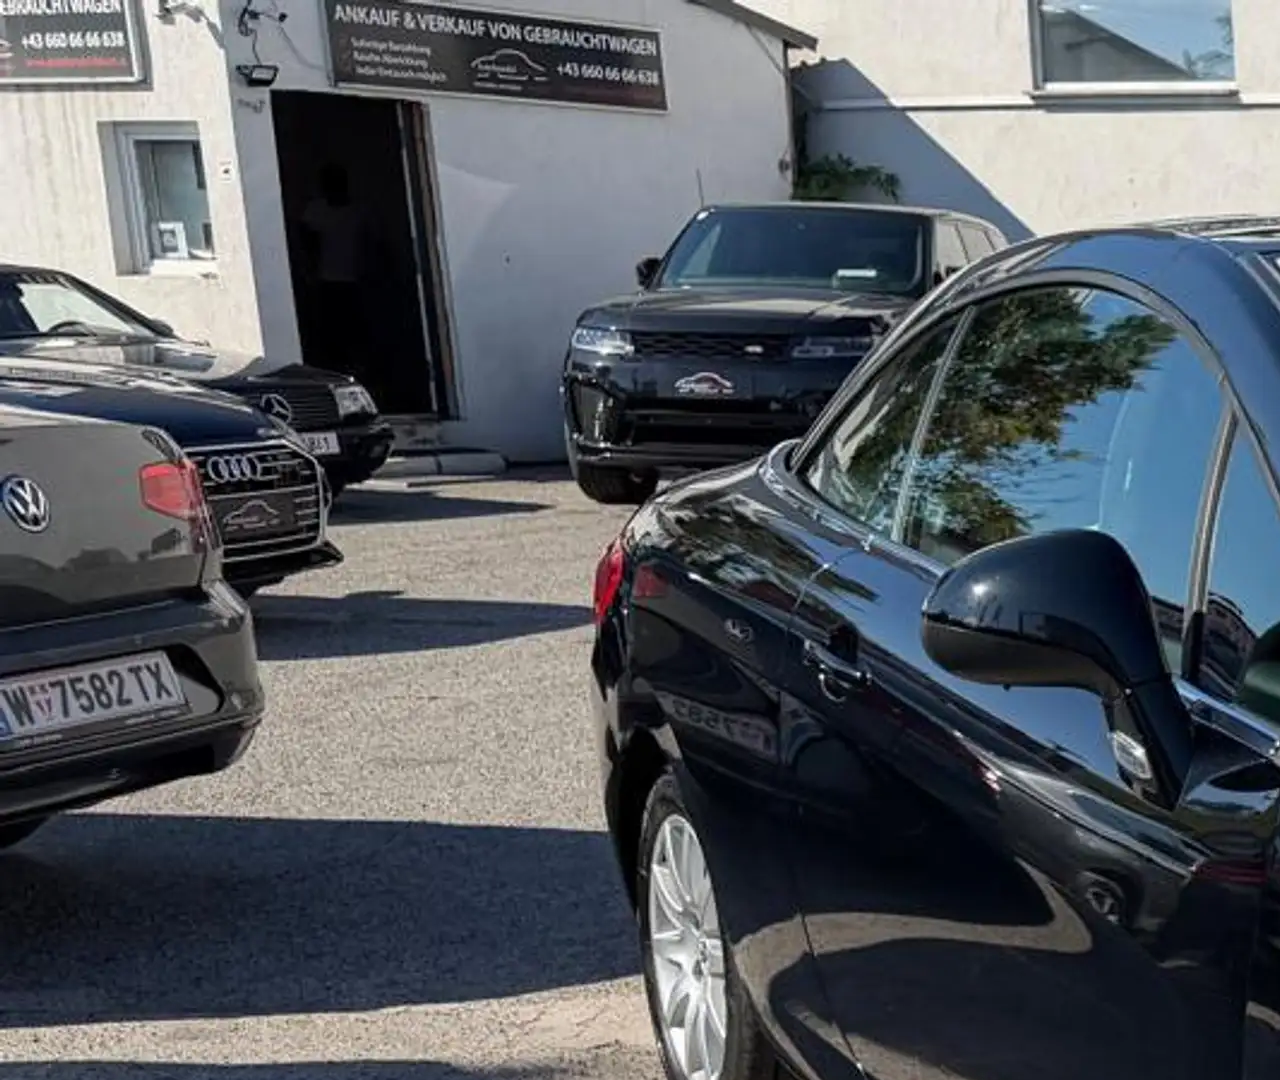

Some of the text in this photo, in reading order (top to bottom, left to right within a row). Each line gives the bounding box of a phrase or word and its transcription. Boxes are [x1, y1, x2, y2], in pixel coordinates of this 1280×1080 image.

[0, 0, 122, 15] EBRAUCHTWAGEN
[21, 32, 43, 49] +43
[45, 31, 66, 48] 660
[334, 4, 657, 55] ANKAUF & VERKAUF VON GEBRAUCHTWAGEN
[557, 61, 660, 86] +43 660 66 66 638
[3, 684, 35, 727] W
